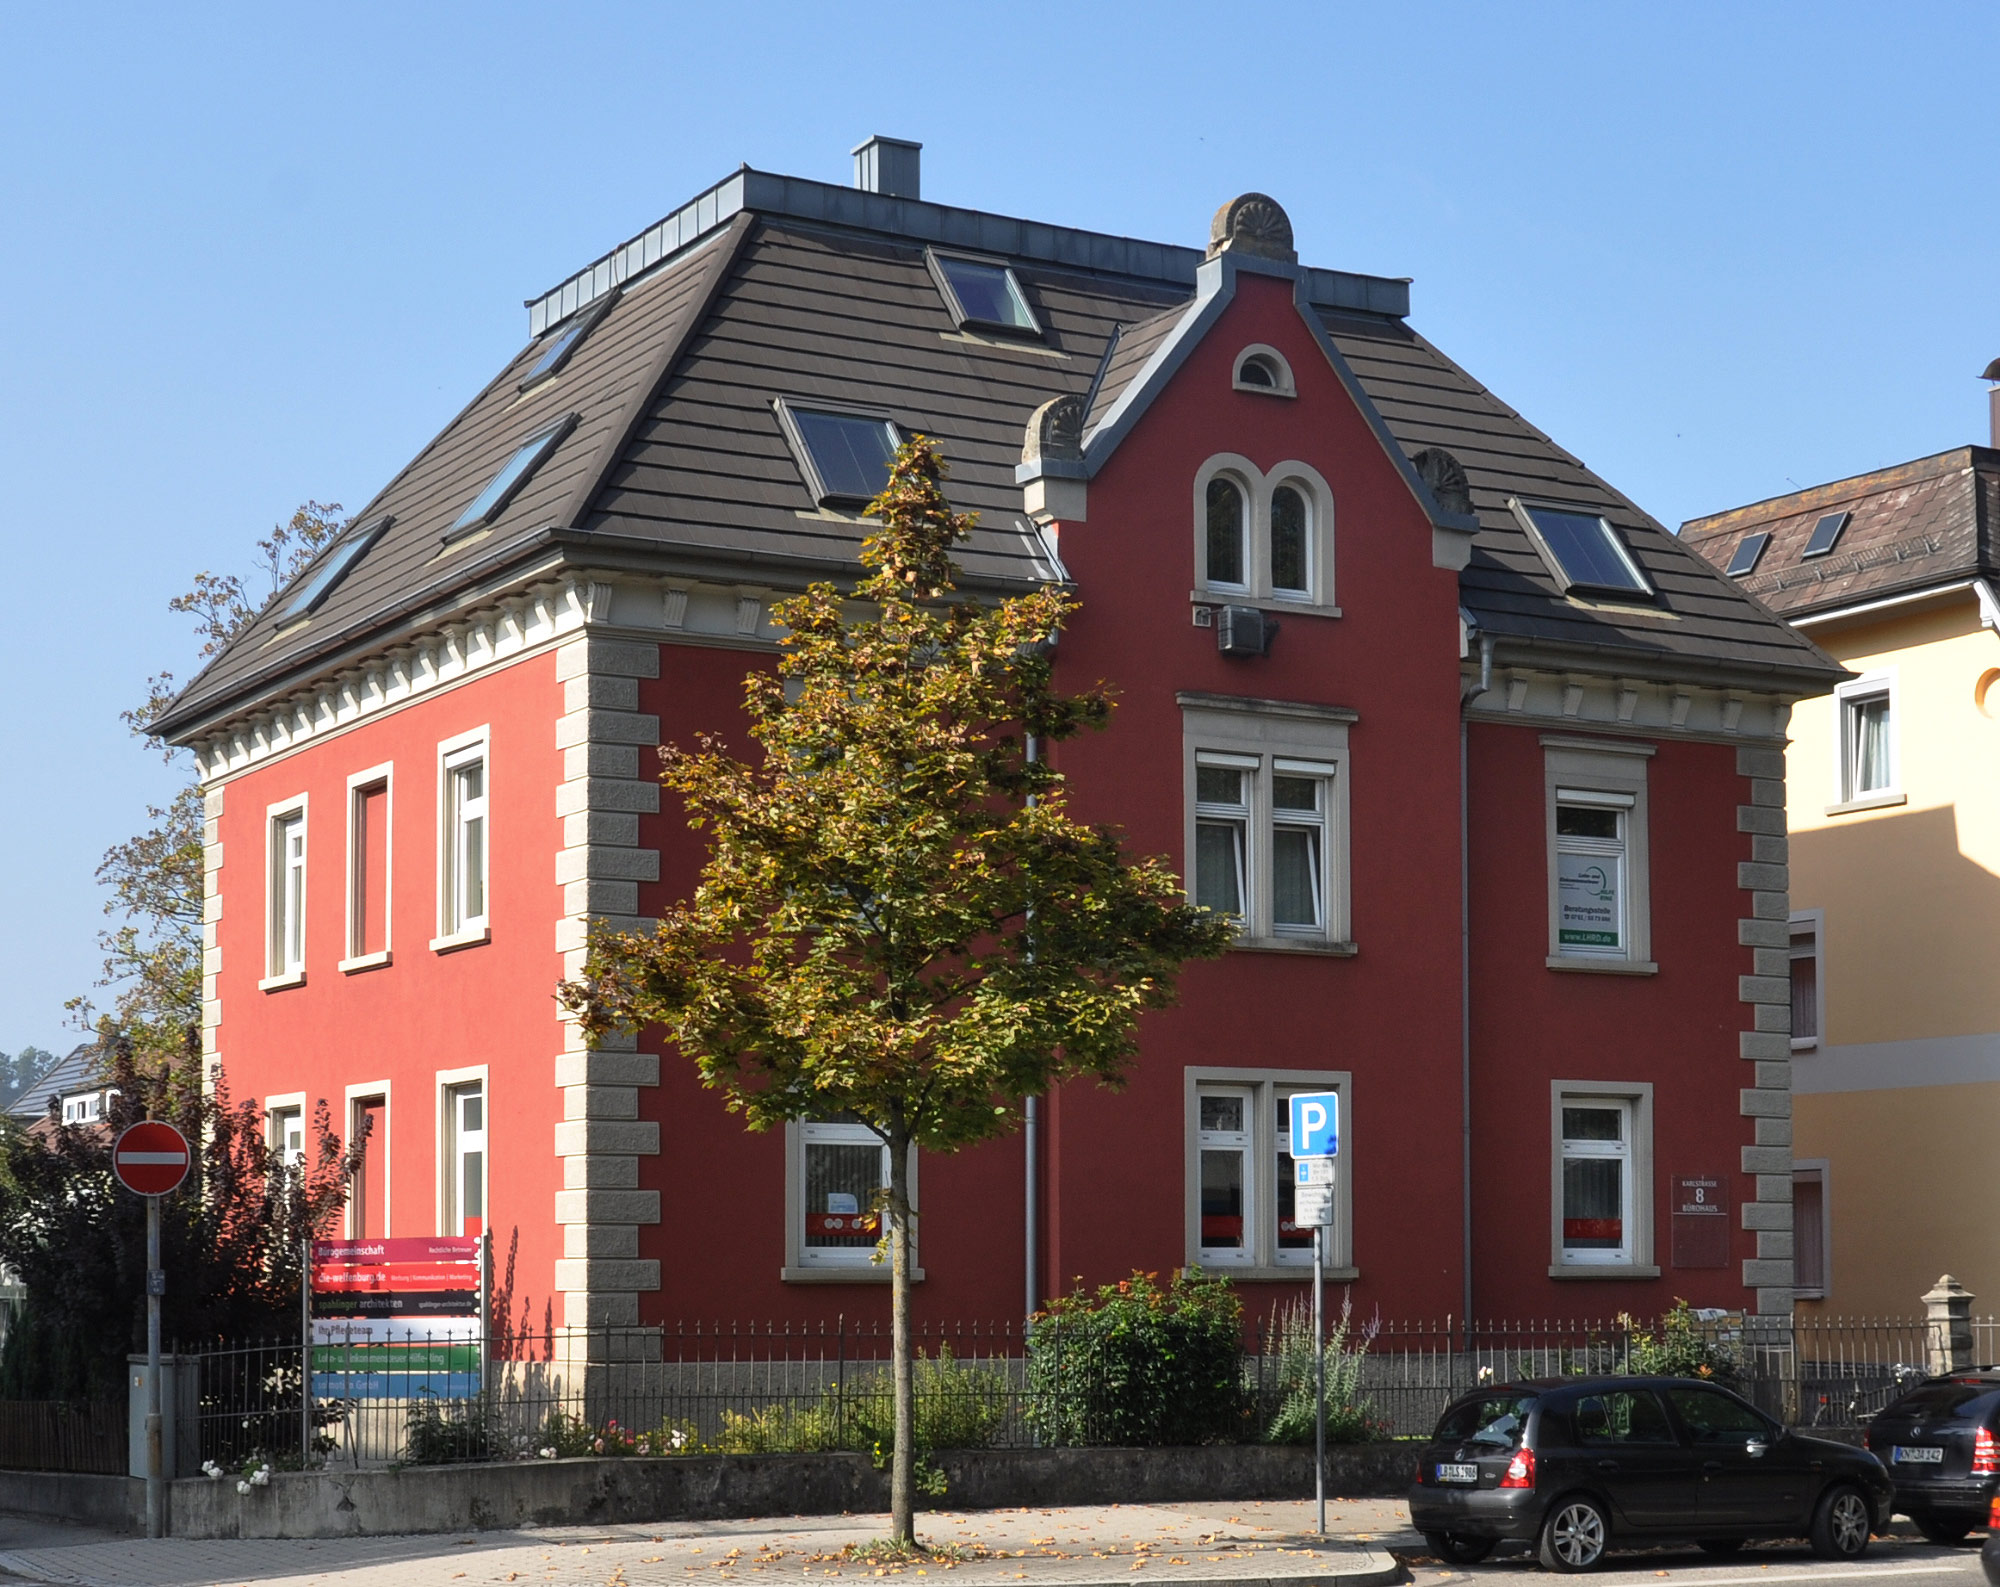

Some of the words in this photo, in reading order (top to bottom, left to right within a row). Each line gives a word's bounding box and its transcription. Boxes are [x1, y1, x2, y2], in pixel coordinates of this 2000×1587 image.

[1302, 1102, 1327, 1149] P
[1696, 1188, 1704, 1203] 8
[1682, 1203, 1718, 1213] BÜROHAUS
[318, 1244, 385, 1259] Bürogemeinschaft
[318, 1271, 386, 1284] die-welfenburg.de
[318, 1300, 358, 1311] spahlinger
[359, 1299, 403, 1309] architekten
[330, 1324, 373, 1336] Pfleeteam
[346, 1352, 407, 1364] inkommensteuer
